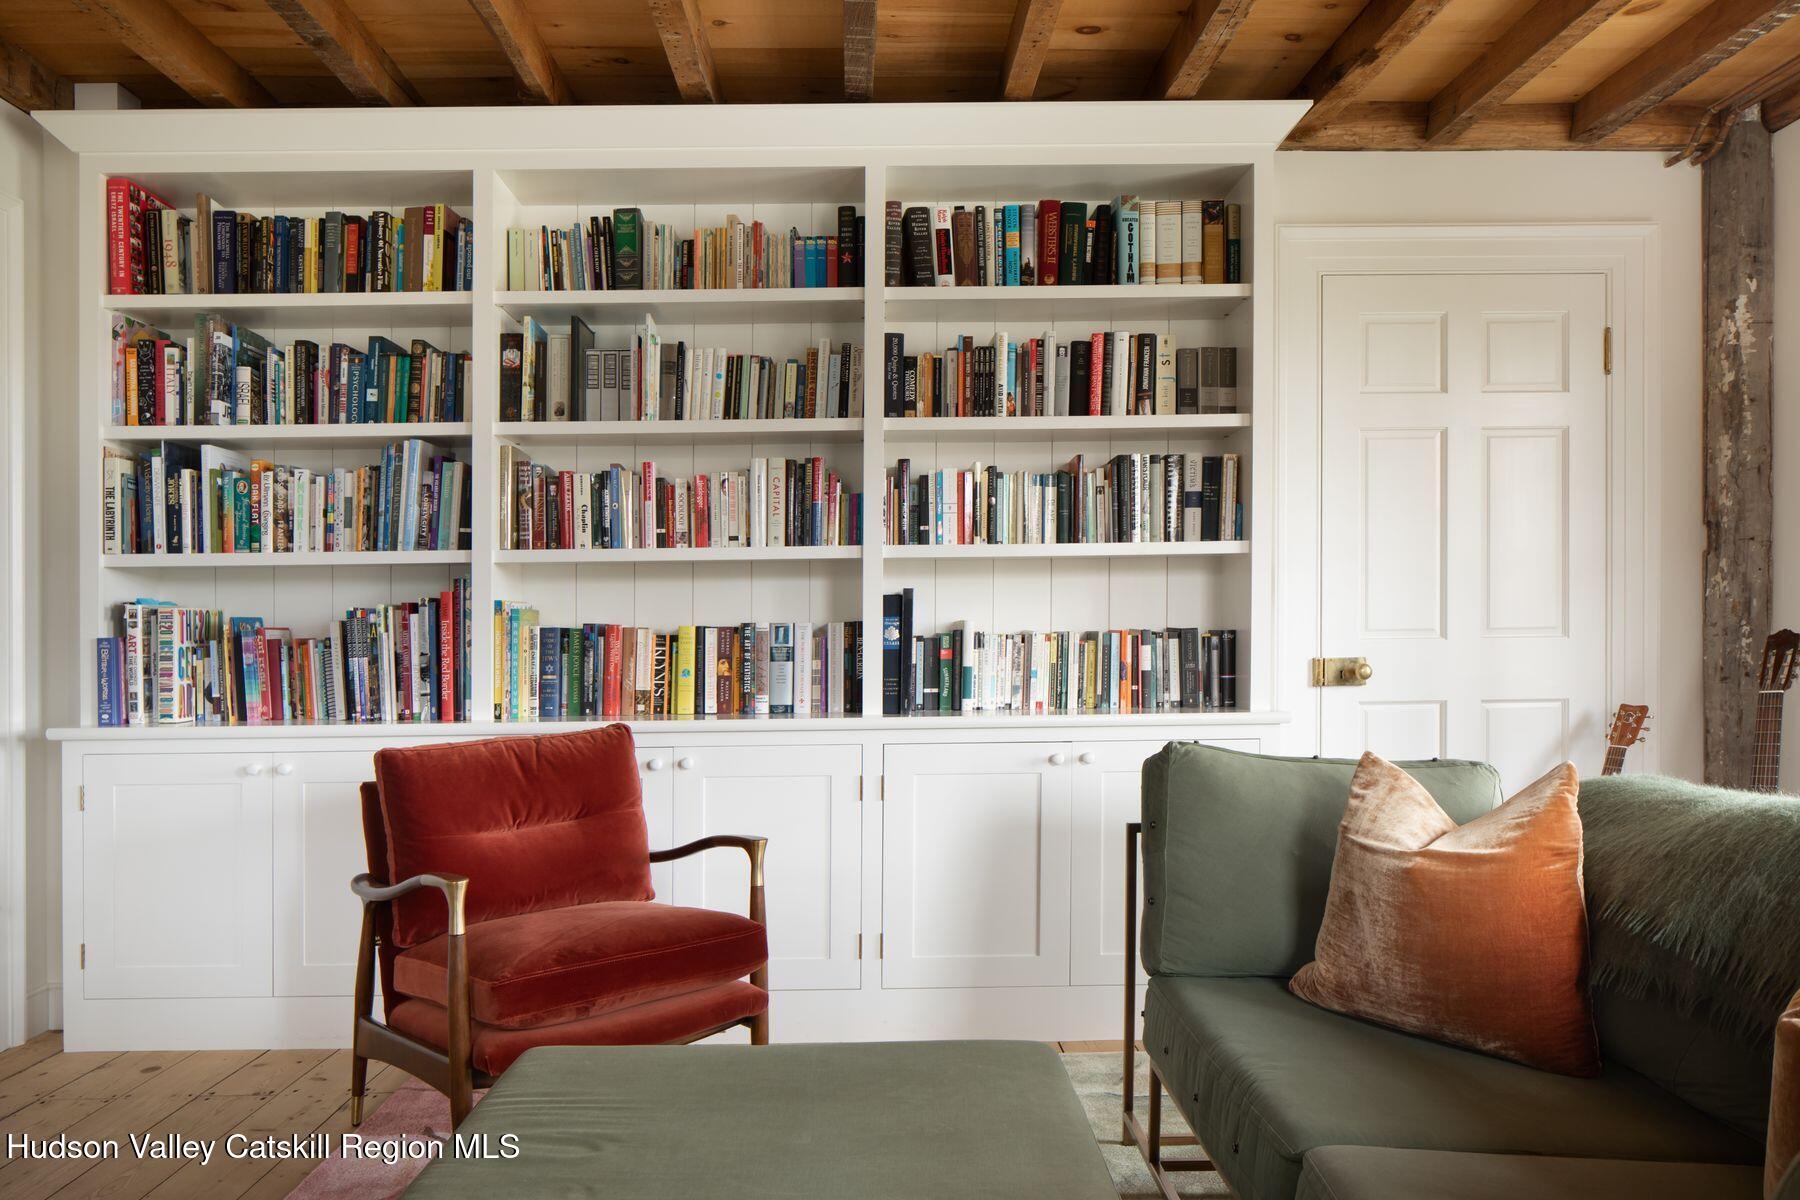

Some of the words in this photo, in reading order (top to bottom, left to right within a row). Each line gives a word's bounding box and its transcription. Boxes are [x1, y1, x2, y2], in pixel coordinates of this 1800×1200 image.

[378, 240, 384, 248] Of
[1047, 212, 1057, 254] WEBSTER'S
[164, 240, 176, 268] 1948
[1127, 223, 1135, 283] GOTHAM
[167, 368, 175, 396] ITALY
[236, 382, 249, 405] ISRAEL
[1189, 460, 1197, 488] VICTIMS
[106, 487, 115, 500] THE
[106, 502, 115, 540] LABYRINTH
[580, 504, 588, 533] Chaplin
[128, 635, 136, 654] ART
[744, 652, 750, 660] OF
[654, 647, 666, 697] KEYNES
